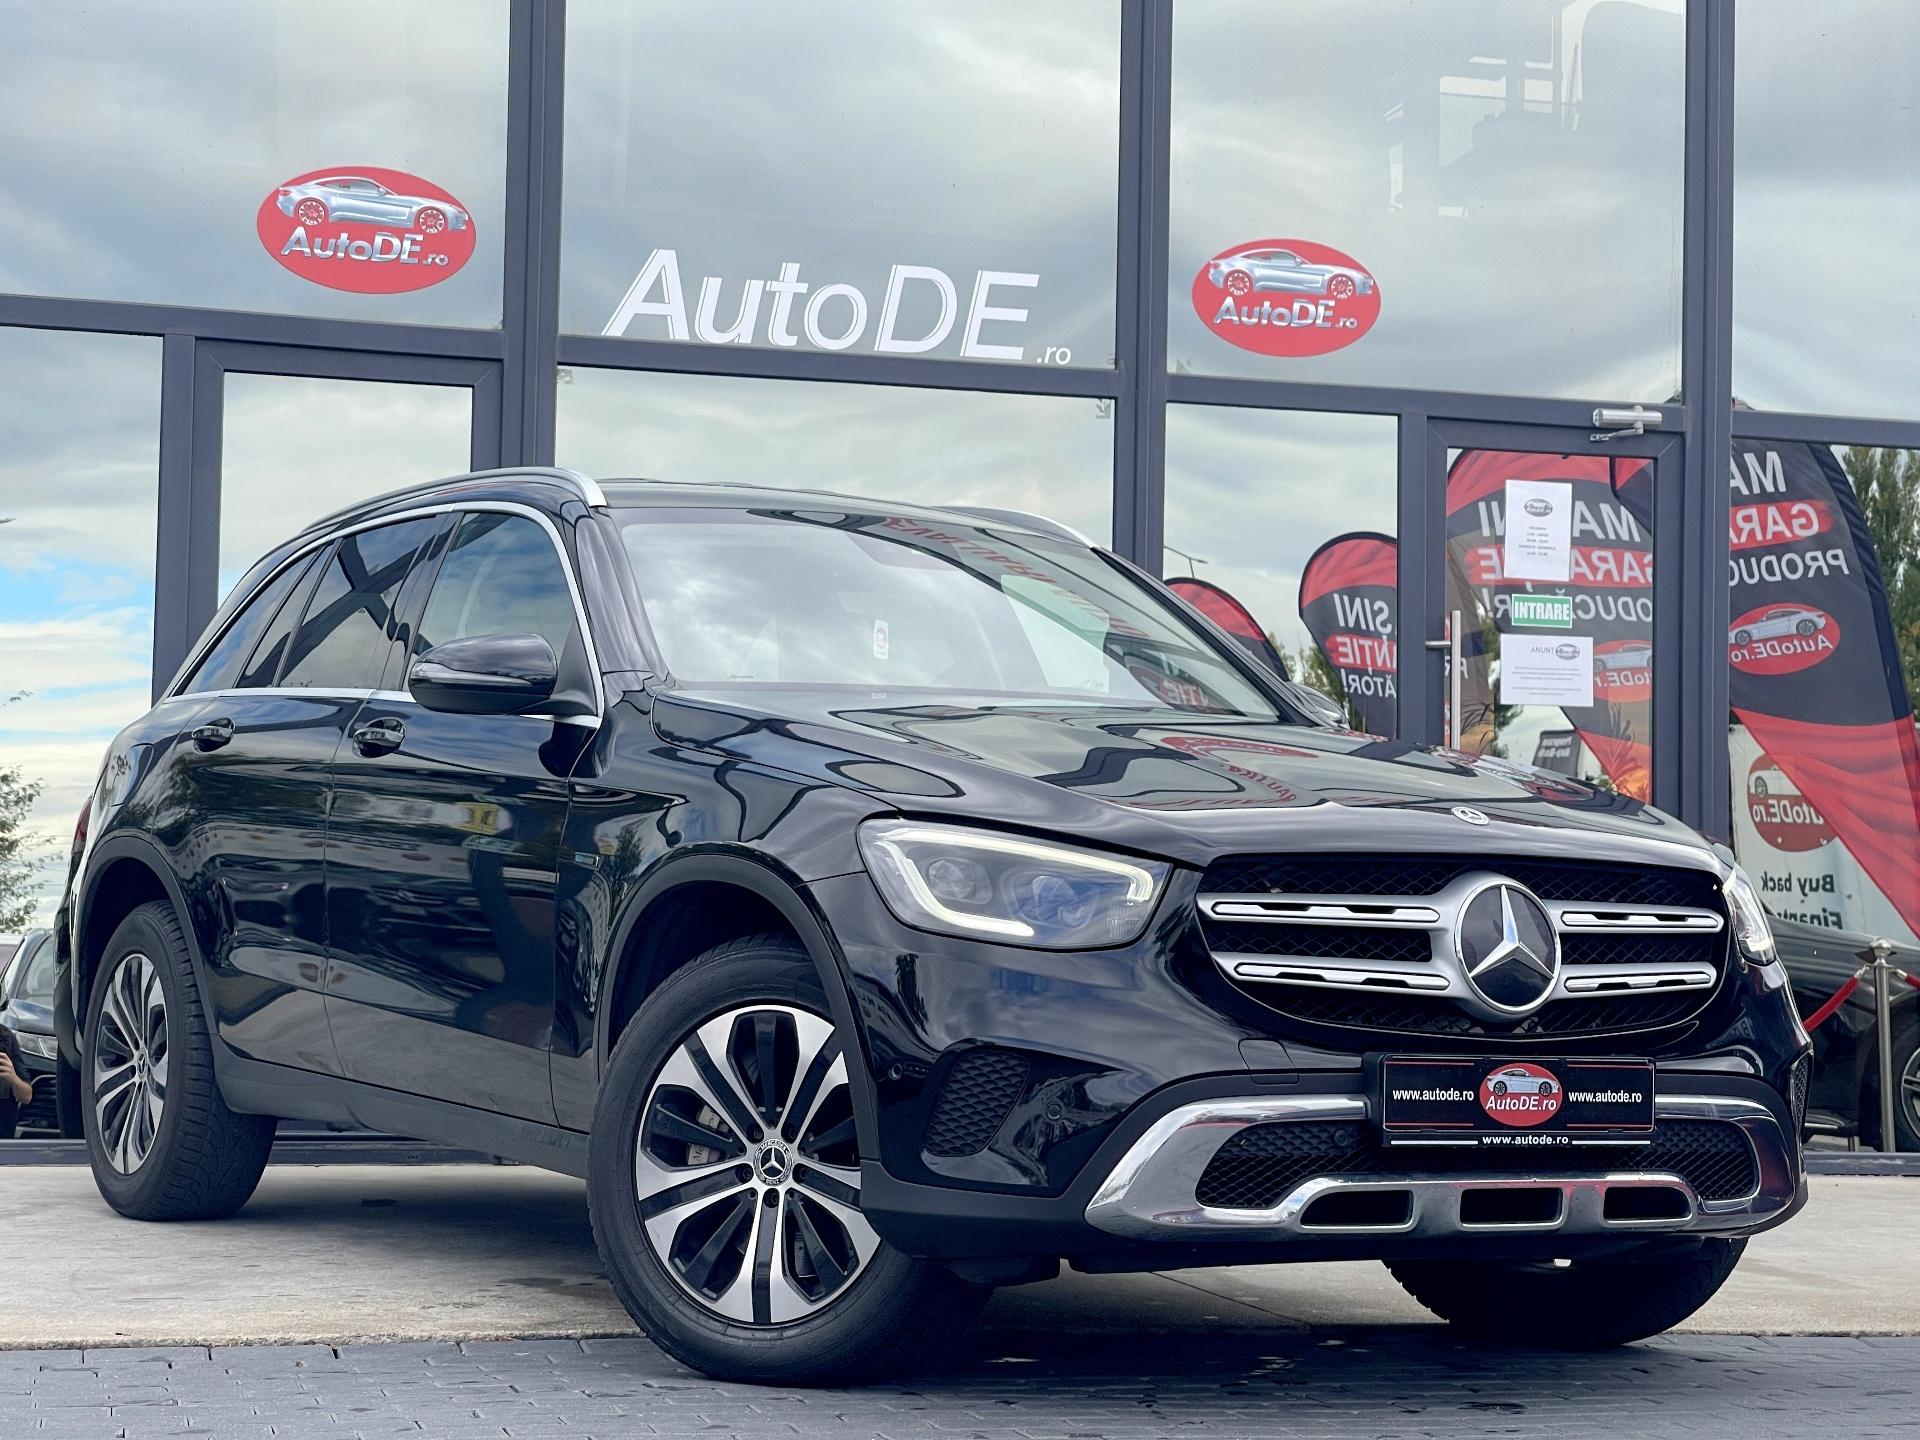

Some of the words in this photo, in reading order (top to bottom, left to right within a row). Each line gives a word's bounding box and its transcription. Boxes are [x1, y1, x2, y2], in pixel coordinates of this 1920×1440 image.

[280, 226, 449, 267] AutoDE.ro
[601, 248, 1072, 365] AutoDE.ro
[1213, 296, 1358, 329] AutoDE.ro
[1514, 601, 1570, 621] INTRARE
[1392, 1087, 1475, 1101] www.autode.ro
[1485, 1095, 1557, 1111] AutoDE.ro
[1568, 1089, 1643, 1103] www.autode.ro
[1481, 1134, 1569, 1145] www.autode.ro
